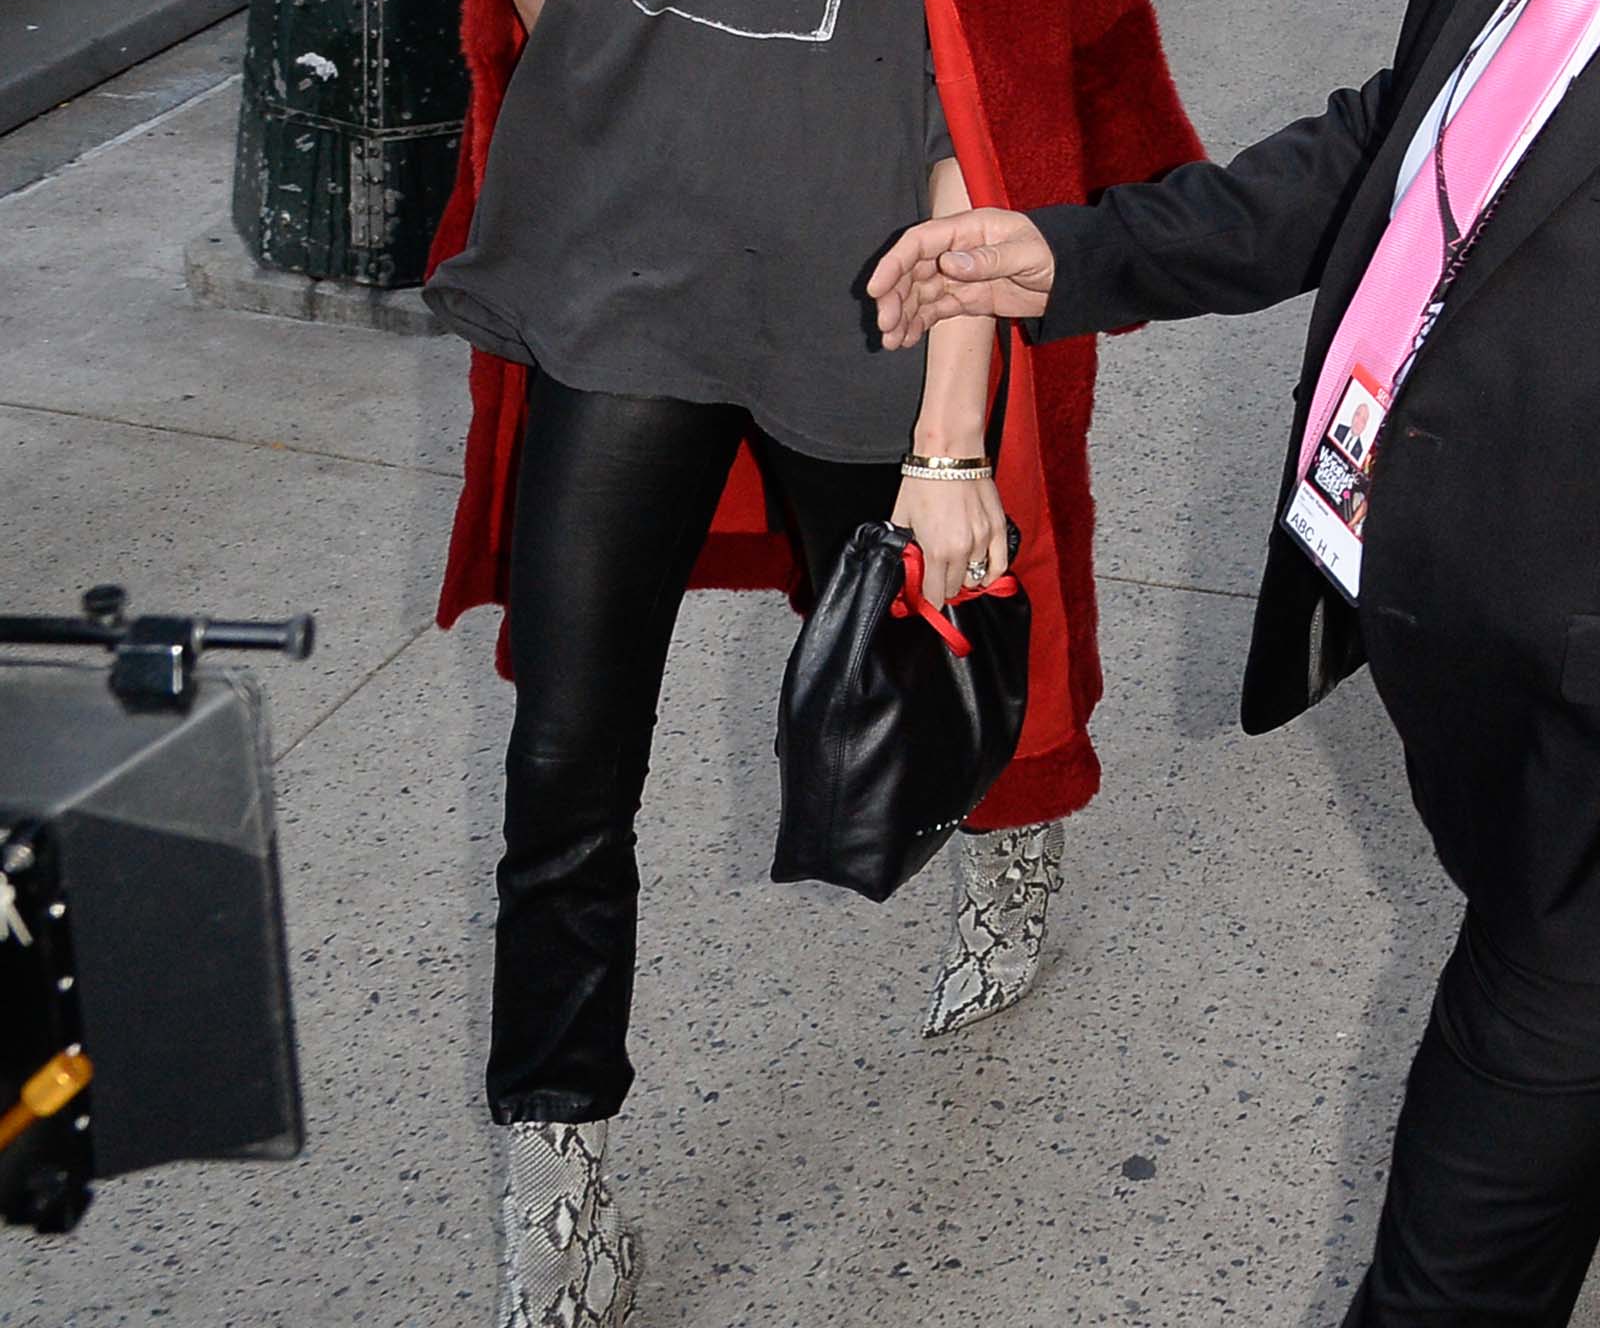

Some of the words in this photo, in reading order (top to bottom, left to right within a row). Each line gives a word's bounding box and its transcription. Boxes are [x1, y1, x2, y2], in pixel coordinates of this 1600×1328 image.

[1290, 512, 1315, 543] ABC
[1316, 538, 1328, 558] H
[1330, 552, 1341, 569] T
